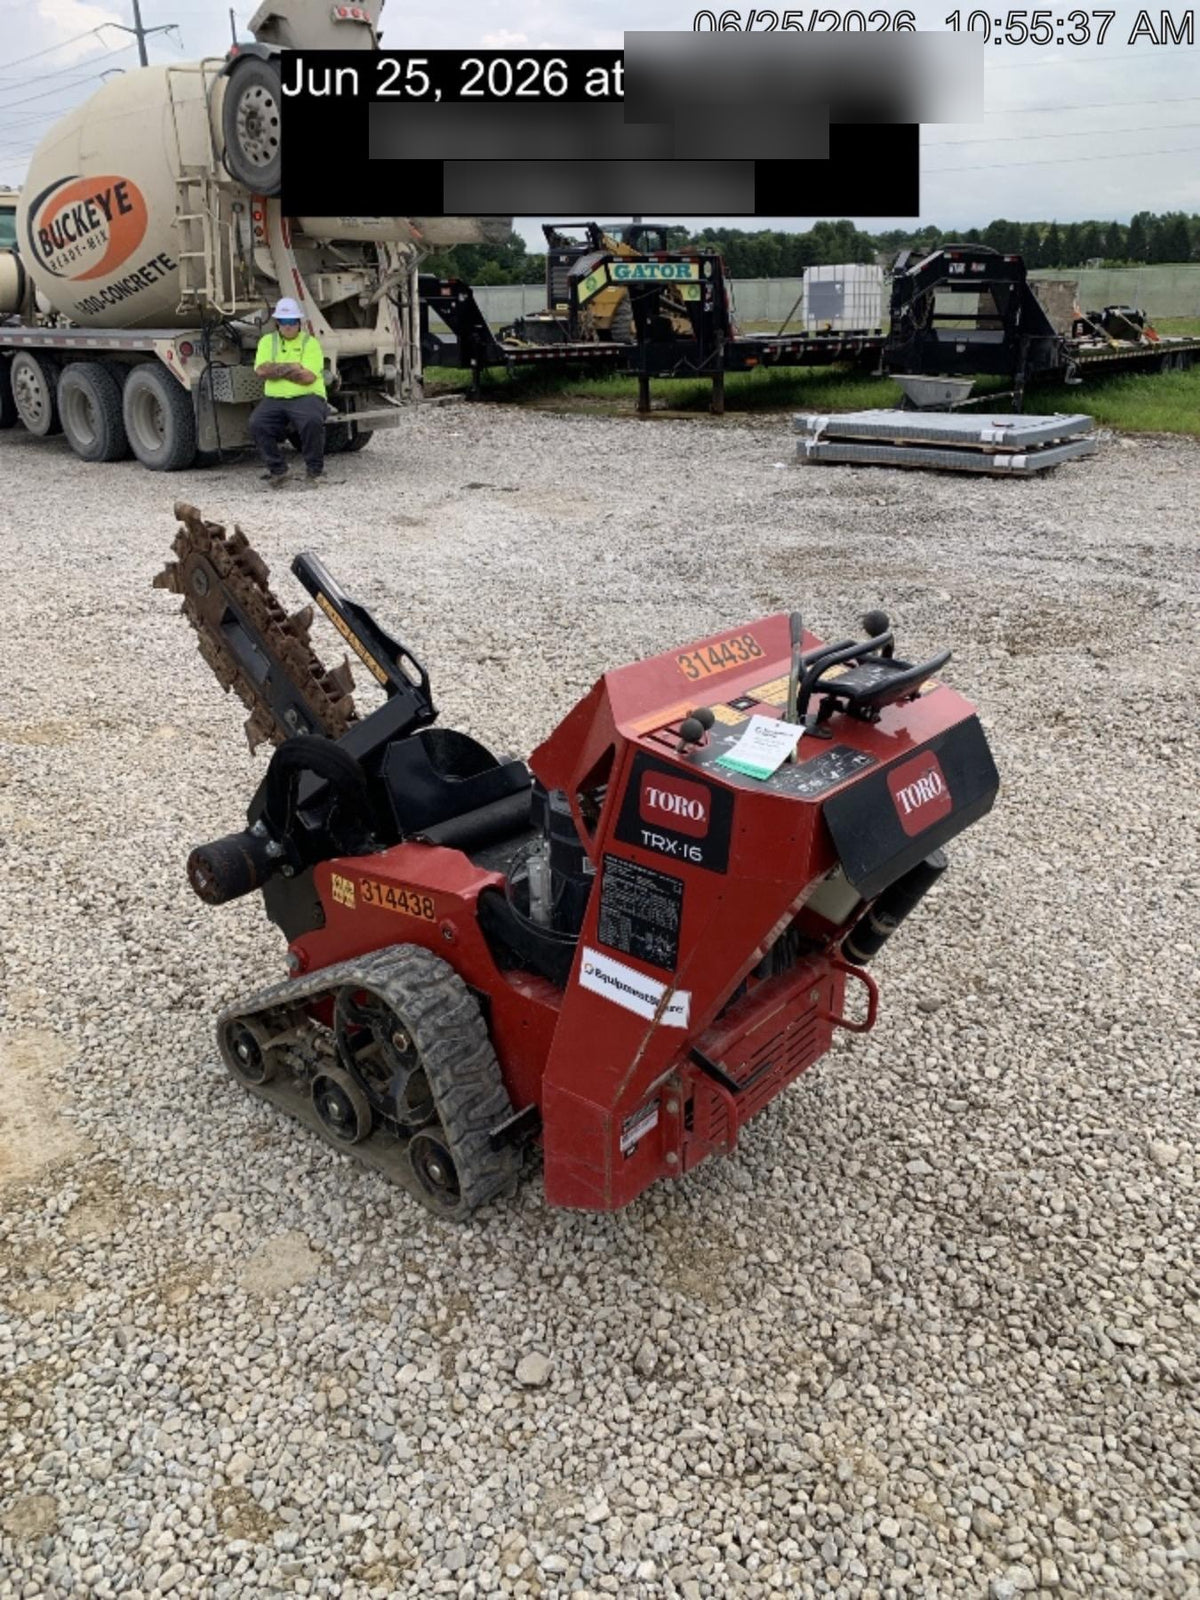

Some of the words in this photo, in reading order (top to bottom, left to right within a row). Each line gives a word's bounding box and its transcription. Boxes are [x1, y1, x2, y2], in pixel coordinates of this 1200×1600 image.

[37, 181, 133, 259] BUCKEYE
[614, 264, 692, 280] GATOR
[678, 634, 762, 679] 314438
[645, 786, 705, 821] TORO
[895, 770, 942, 815] TORO
[361, 879, 436, 920] 314438
[594, 967, 685, 1014] EquipmentSre
